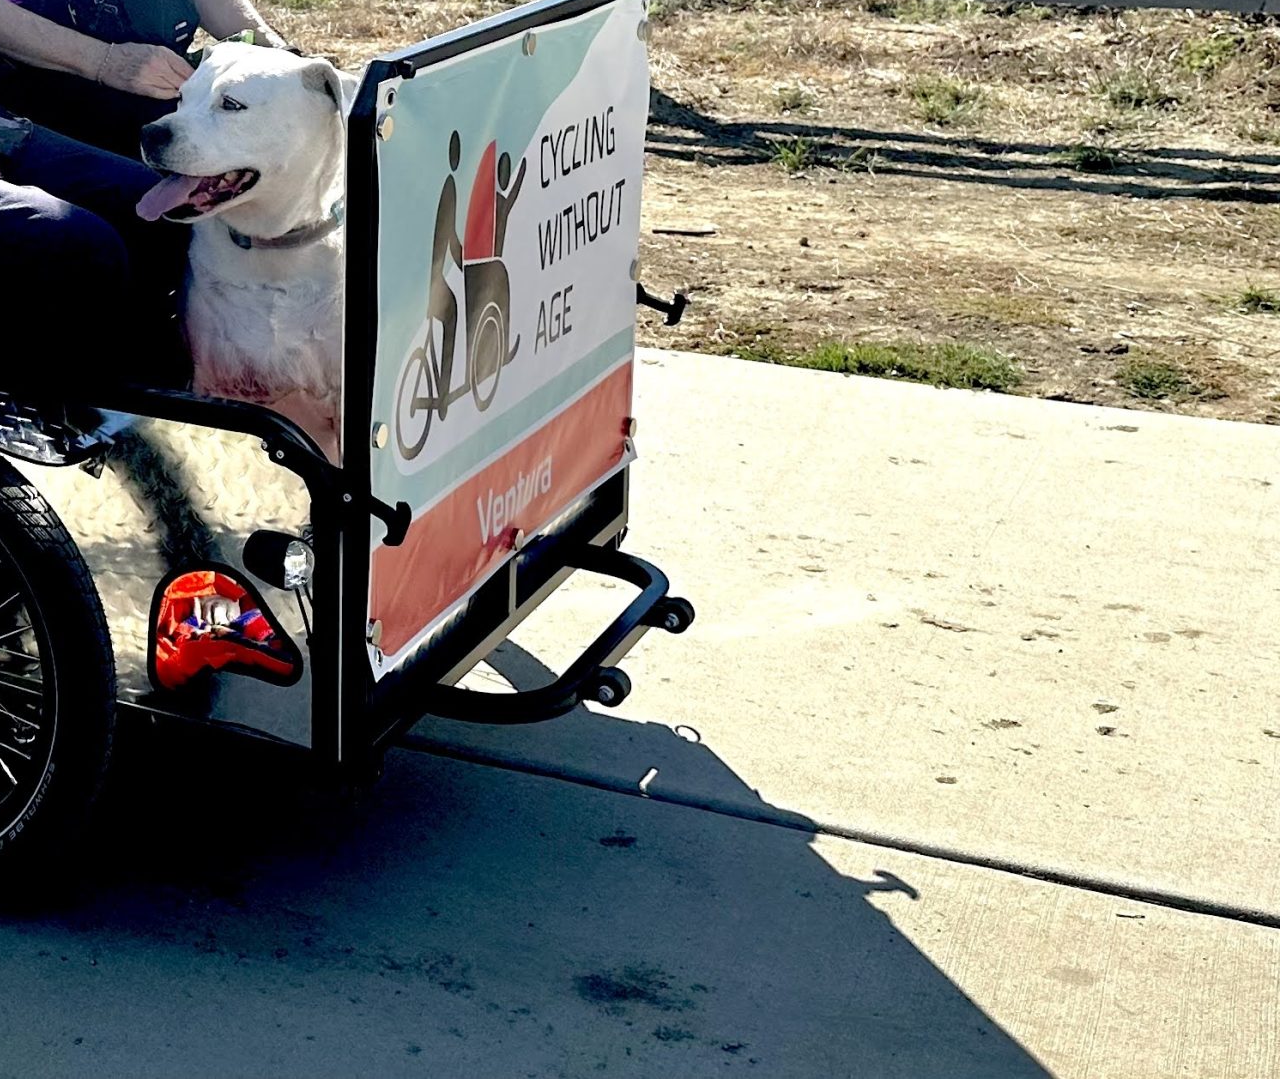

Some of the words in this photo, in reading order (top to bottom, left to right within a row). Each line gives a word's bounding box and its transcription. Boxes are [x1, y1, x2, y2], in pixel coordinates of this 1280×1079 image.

[538, 104, 616, 190] CYCLING
[536, 178, 626, 270] WITHOUT
[534, 283, 574, 356] AGE
[476, 450, 552, 546] Ventura
